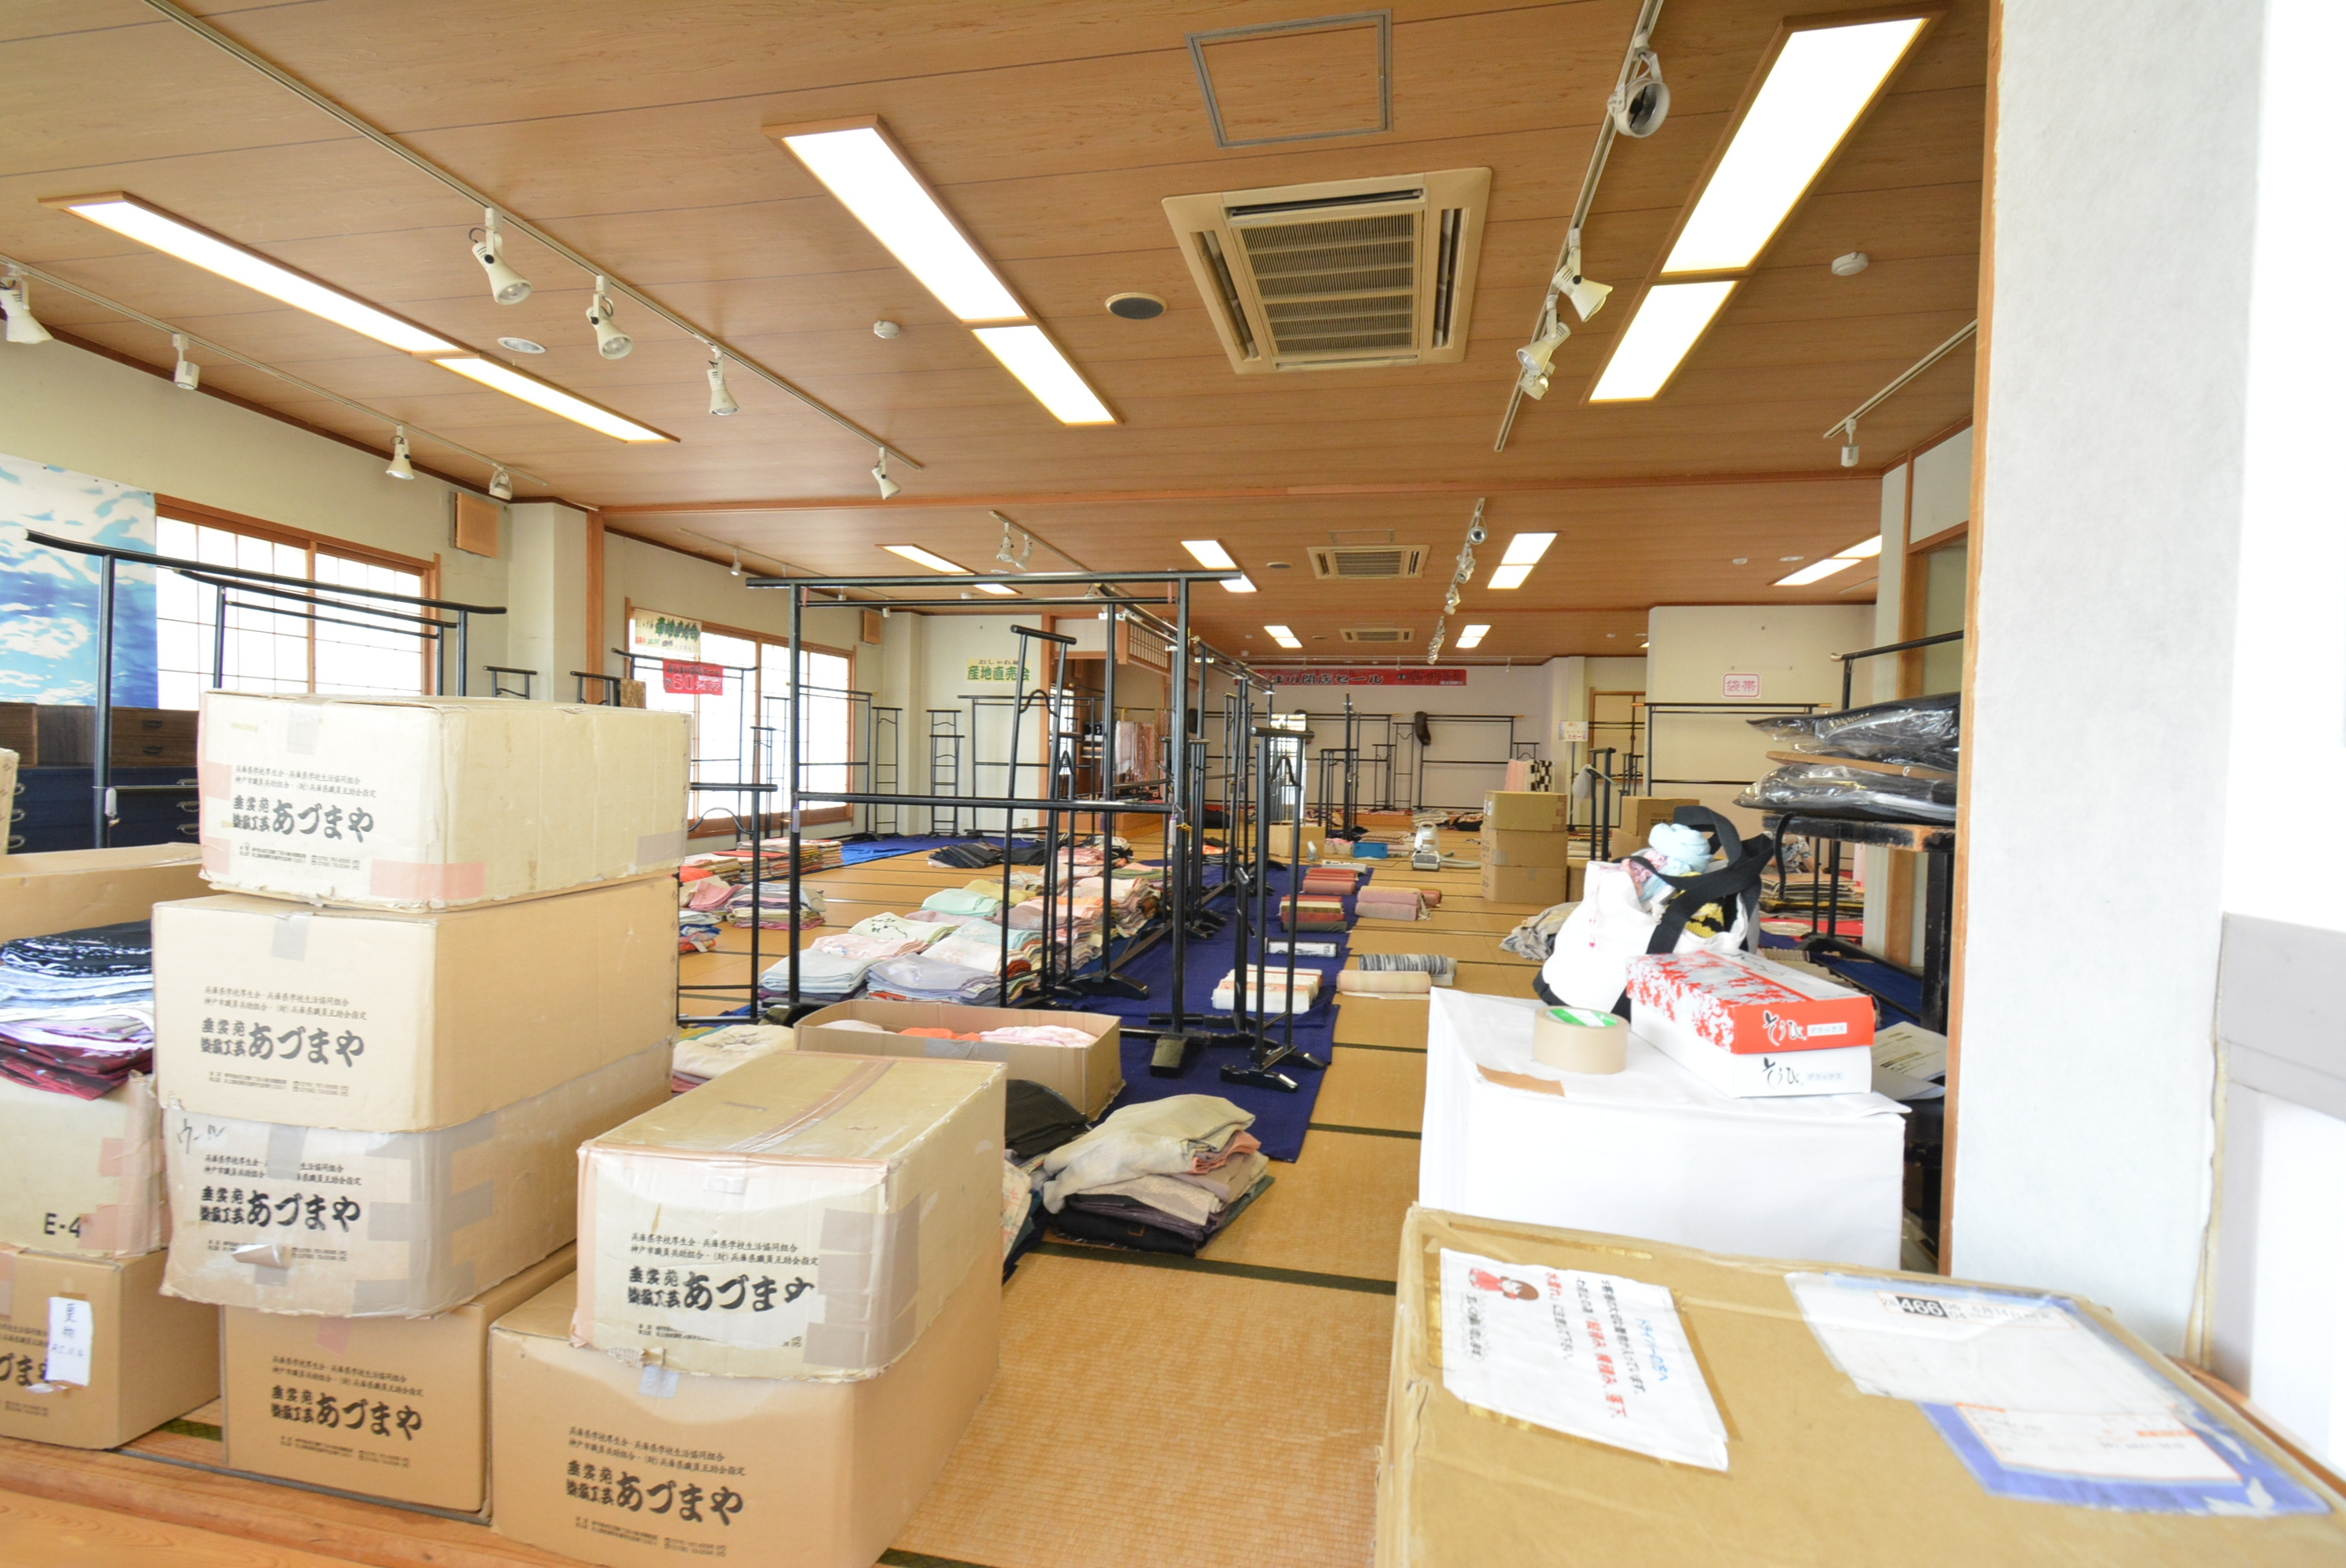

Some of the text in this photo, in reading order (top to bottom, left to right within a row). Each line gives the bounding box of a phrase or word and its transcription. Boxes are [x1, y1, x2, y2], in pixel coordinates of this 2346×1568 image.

[1248, 673, 1384, 685] まい閉店セール
[1727, 680, 1756, 692] 袋帯
[273, 799, 374, 843] あづまや
[249, 1022, 364, 1068] あづまや
[44, 1213, 81, 1238] E-4
[247, 1189, 361, 1232] あづまや
[1901, 1298, 1944, 1316] 466
[316, 1392, 422, 1441] あづまや
[616, 1471, 743, 1526] あづまや
